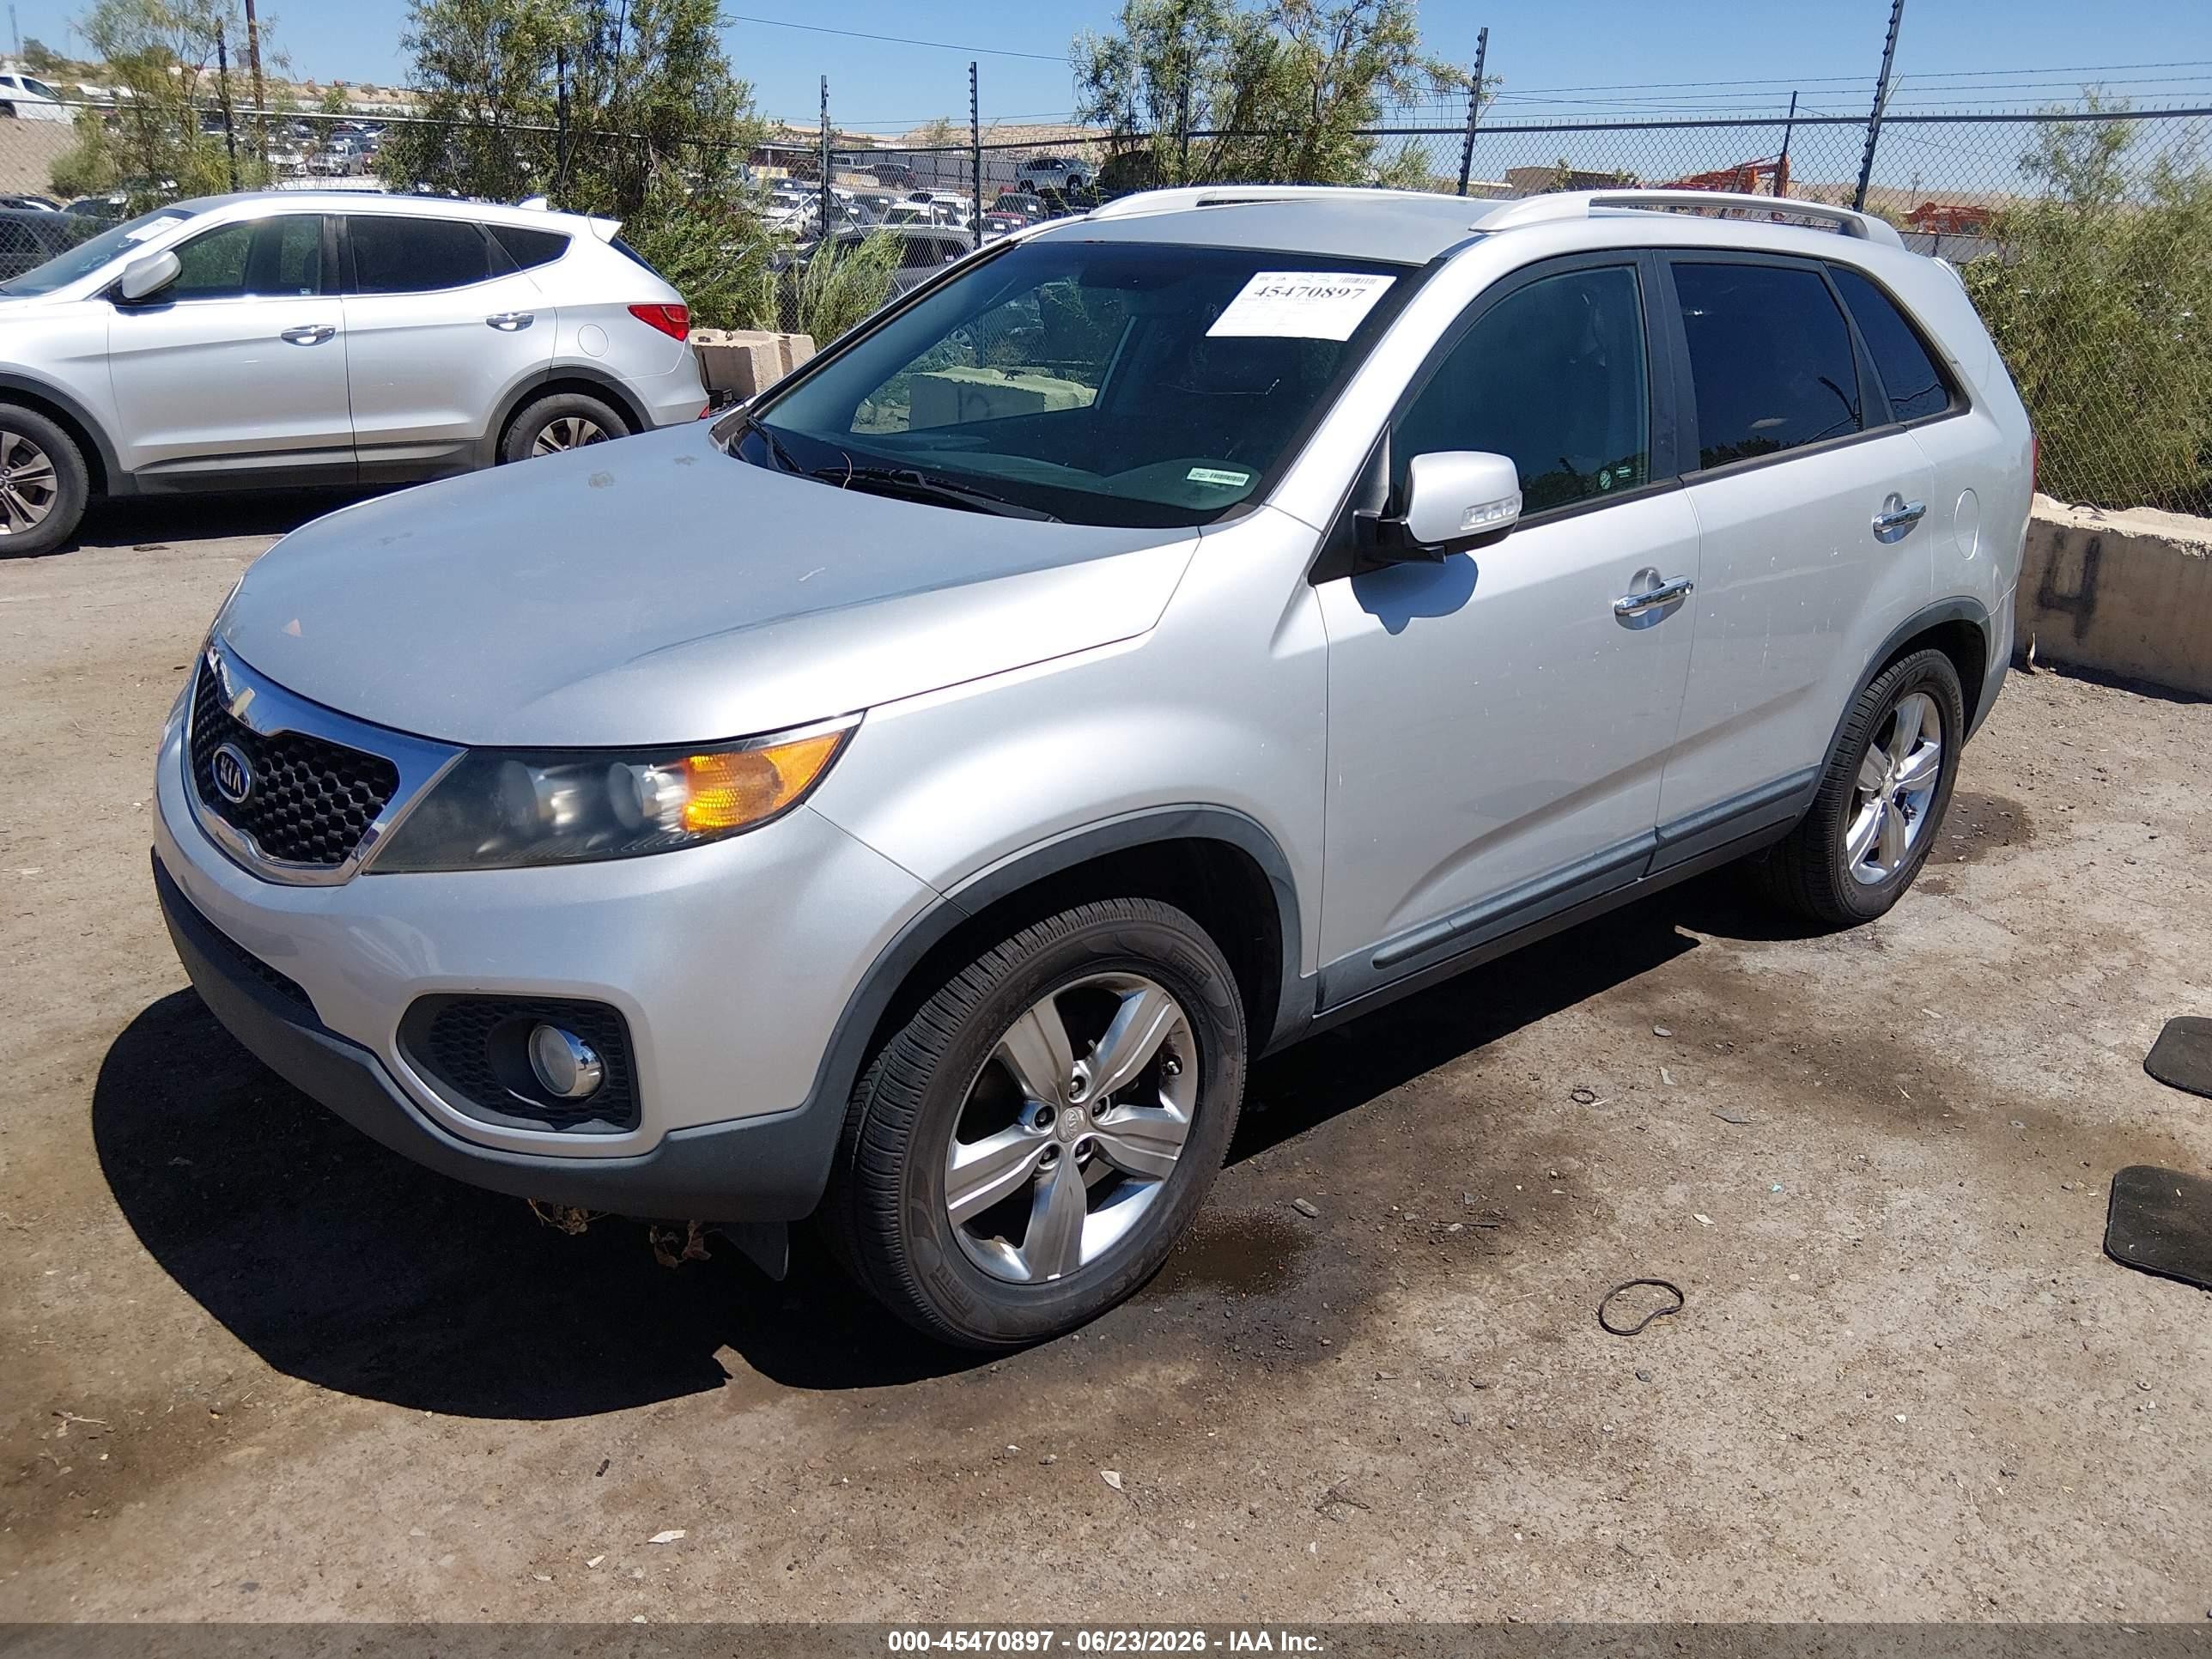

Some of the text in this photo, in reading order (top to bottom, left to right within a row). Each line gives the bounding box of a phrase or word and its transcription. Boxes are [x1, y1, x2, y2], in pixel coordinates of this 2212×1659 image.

[1254, 285, 1366, 300] 45470897
[2037, 530, 2101, 641] 4
[220, 755, 242, 795] KIA
